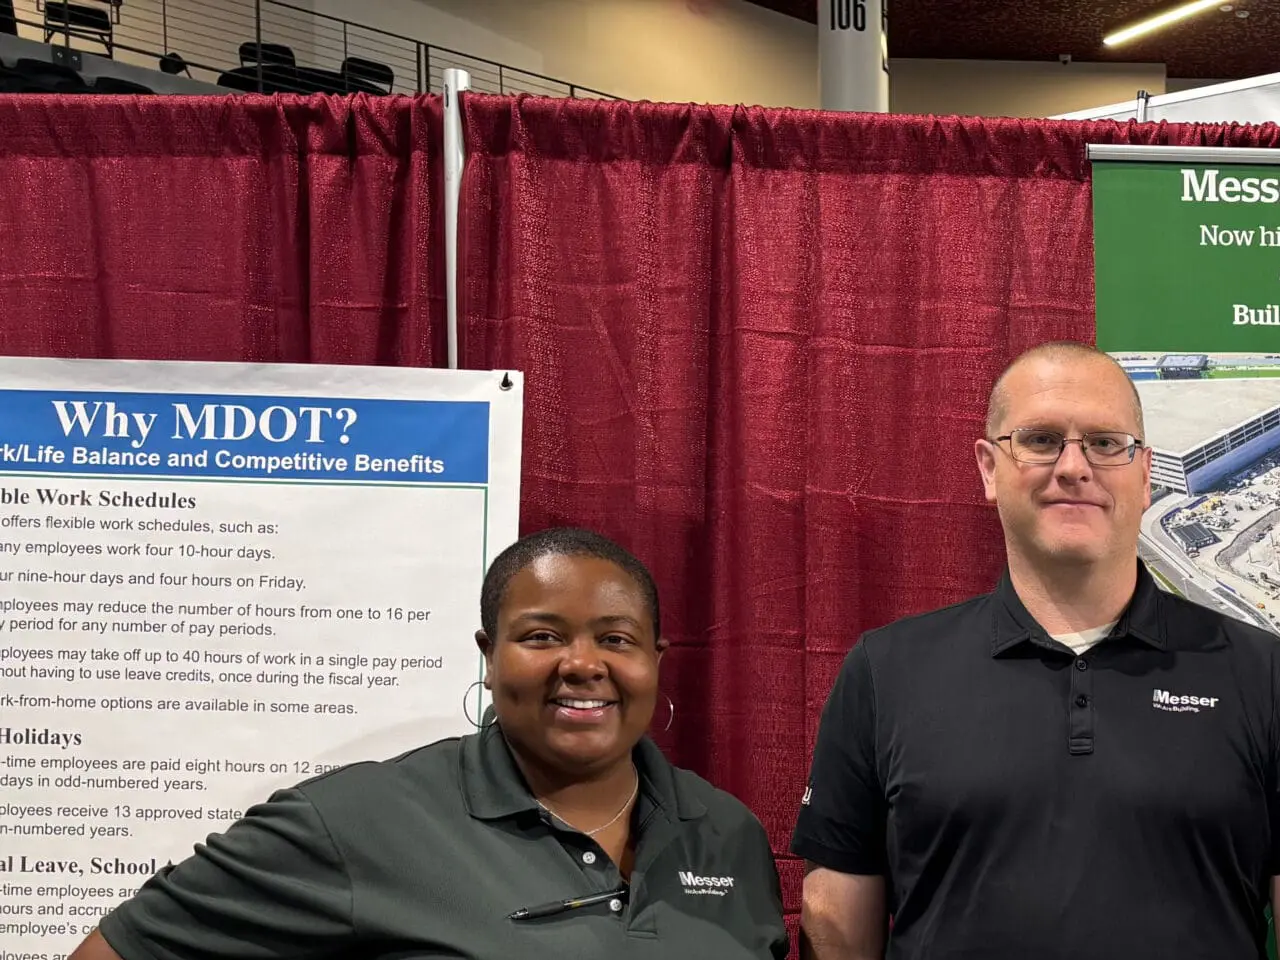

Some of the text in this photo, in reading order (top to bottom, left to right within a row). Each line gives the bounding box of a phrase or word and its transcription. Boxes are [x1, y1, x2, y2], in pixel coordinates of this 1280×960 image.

[1199, 224, 1255, 246] Now
[52, 400, 358, 448] Why MDOT?
[0, 443, 444, 474] k/Life Balance and Competitive Benefits
[36, 488, 92, 506] Work
[98, 490, 196, 509] Schedules
[1, 514, 278, 534] offers flexible work schedules, such as:
[25, 541, 275, 562] employees work four 10-hour days.
[17, 569, 306, 592] nine-hour days and four hours on Friday.
[1153, 688, 1219, 708] Messer
[0, 773, 207, 793] days in odd-numbered years.
[56, 804, 242, 821] receive 13 approved state
[20, 856, 156, 876] Leave, School
[679, 872, 734, 887] Messer
